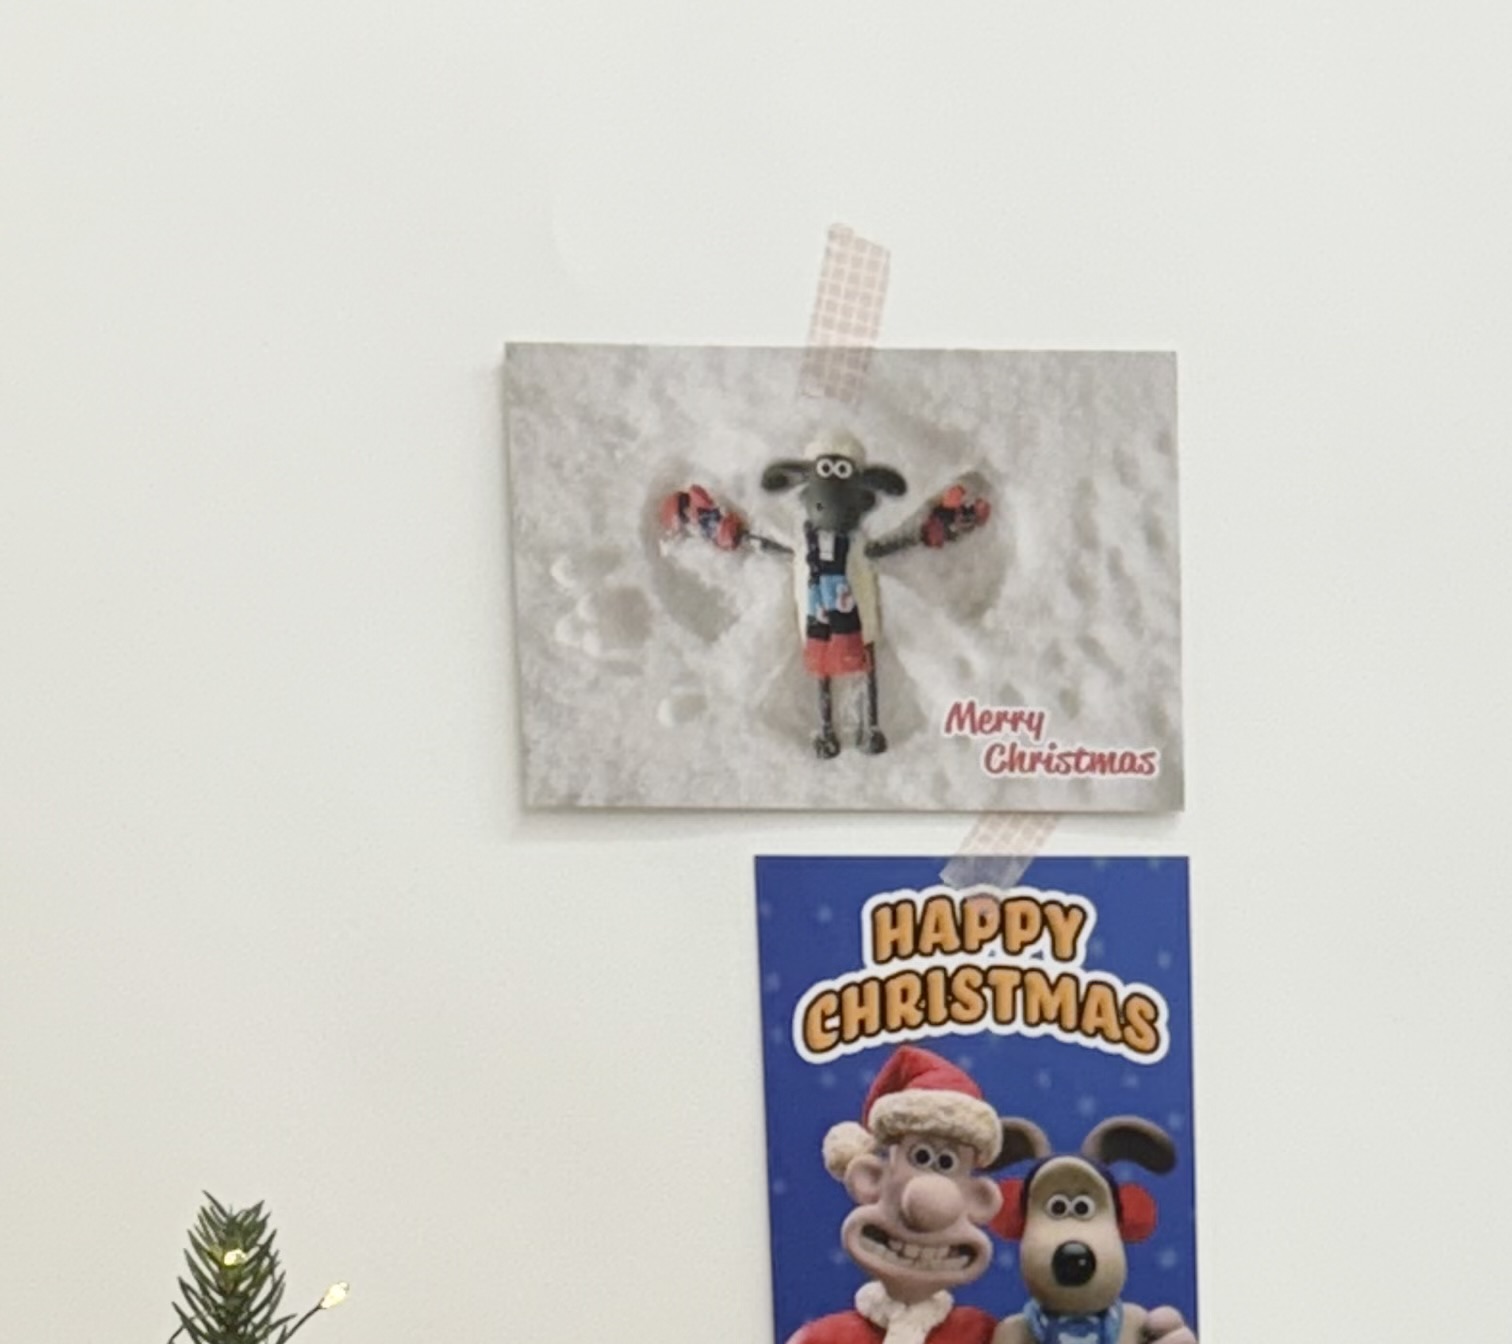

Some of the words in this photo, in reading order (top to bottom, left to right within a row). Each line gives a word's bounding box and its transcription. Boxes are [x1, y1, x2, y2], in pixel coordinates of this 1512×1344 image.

[944, 700, 1045, 741] Merry
[984, 742, 1157, 775] Christmas
[871, 893, 1086, 965] HAPPY
[802, 963, 1164, 1055] CHRISTMAS
